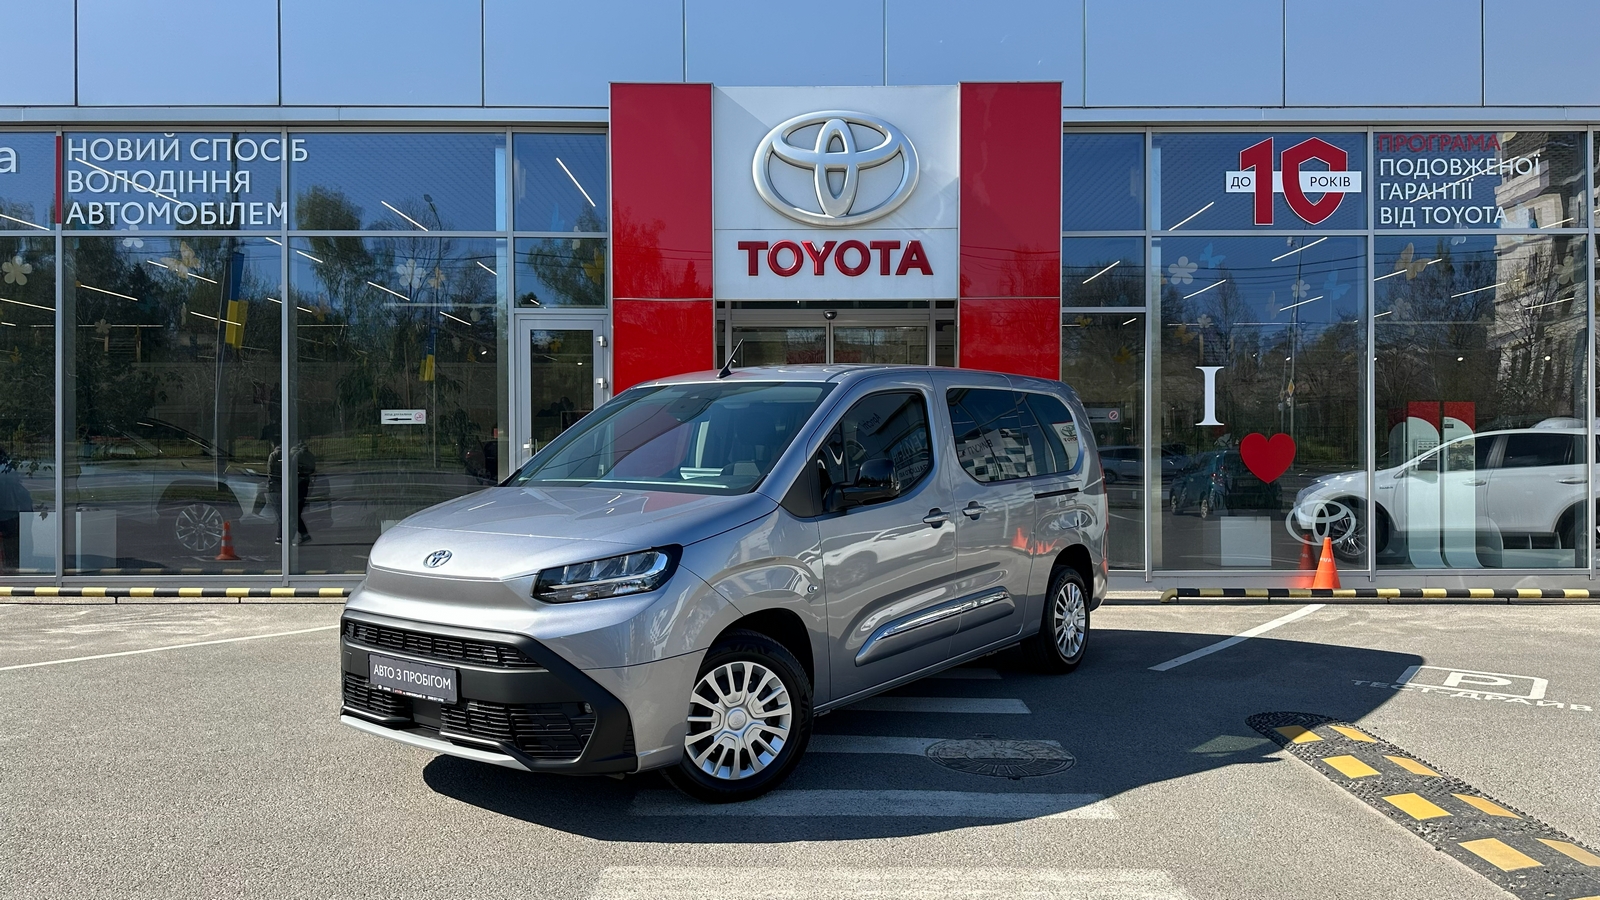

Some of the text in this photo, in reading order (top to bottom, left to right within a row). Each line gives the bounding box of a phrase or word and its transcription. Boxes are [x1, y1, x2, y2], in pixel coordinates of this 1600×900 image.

[67, 133, 308, 161] НОВИЙ СПОСІБ
[1379, 134, 1501, 152] ПРОГРАМА
[1380, 154, 1541, 179] ПОДОВЖЕНОЇ
[67, 170, 250, 198] ВОЛОДІННЯ
[1230, 177, 1251, 189] ДО
[1310, 177, 1351, 188] РОКІВ
[1381, 178, 1473, 200] ГАРАНТІЇ
[66, 202, 288, 225] АВТОМОБІЛЕМ
[1381, 206, 1509, 227] ВІД TOYOTA
[738, 240, 934, 277] TOYOTA
[1195, 366, 1224, 426] I
[373, 664, 394, 679] АВТО
[403, 670, 451, 690] ПРОБІГОМ
[1351, 679, 1594, 712] ТЕСТ-ДРАЙВ
